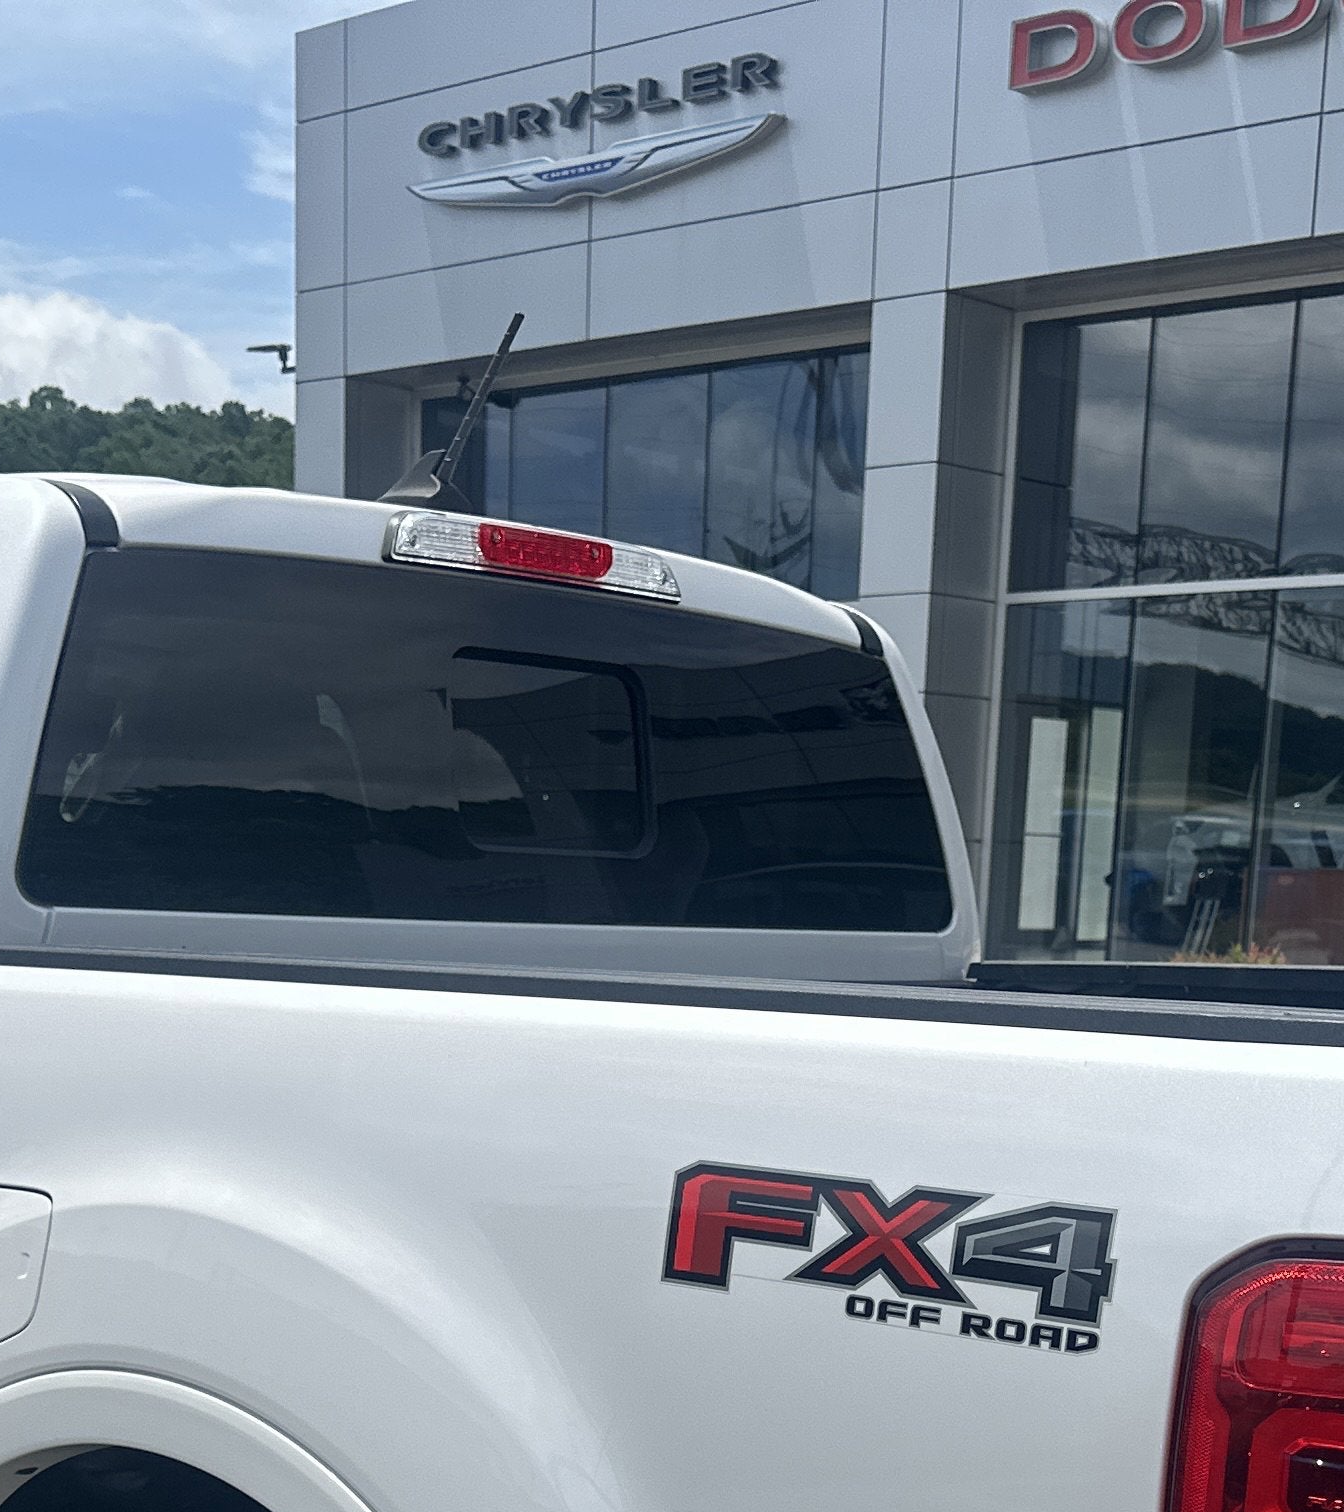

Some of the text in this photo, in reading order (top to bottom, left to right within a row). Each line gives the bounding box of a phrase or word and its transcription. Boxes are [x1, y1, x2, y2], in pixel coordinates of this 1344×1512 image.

[417, 51, 782, 158] CHRYSLER
[660, 1159, 1119, 1330] FX4
[844, 1293, 1100, 1355] OFF ROAD
